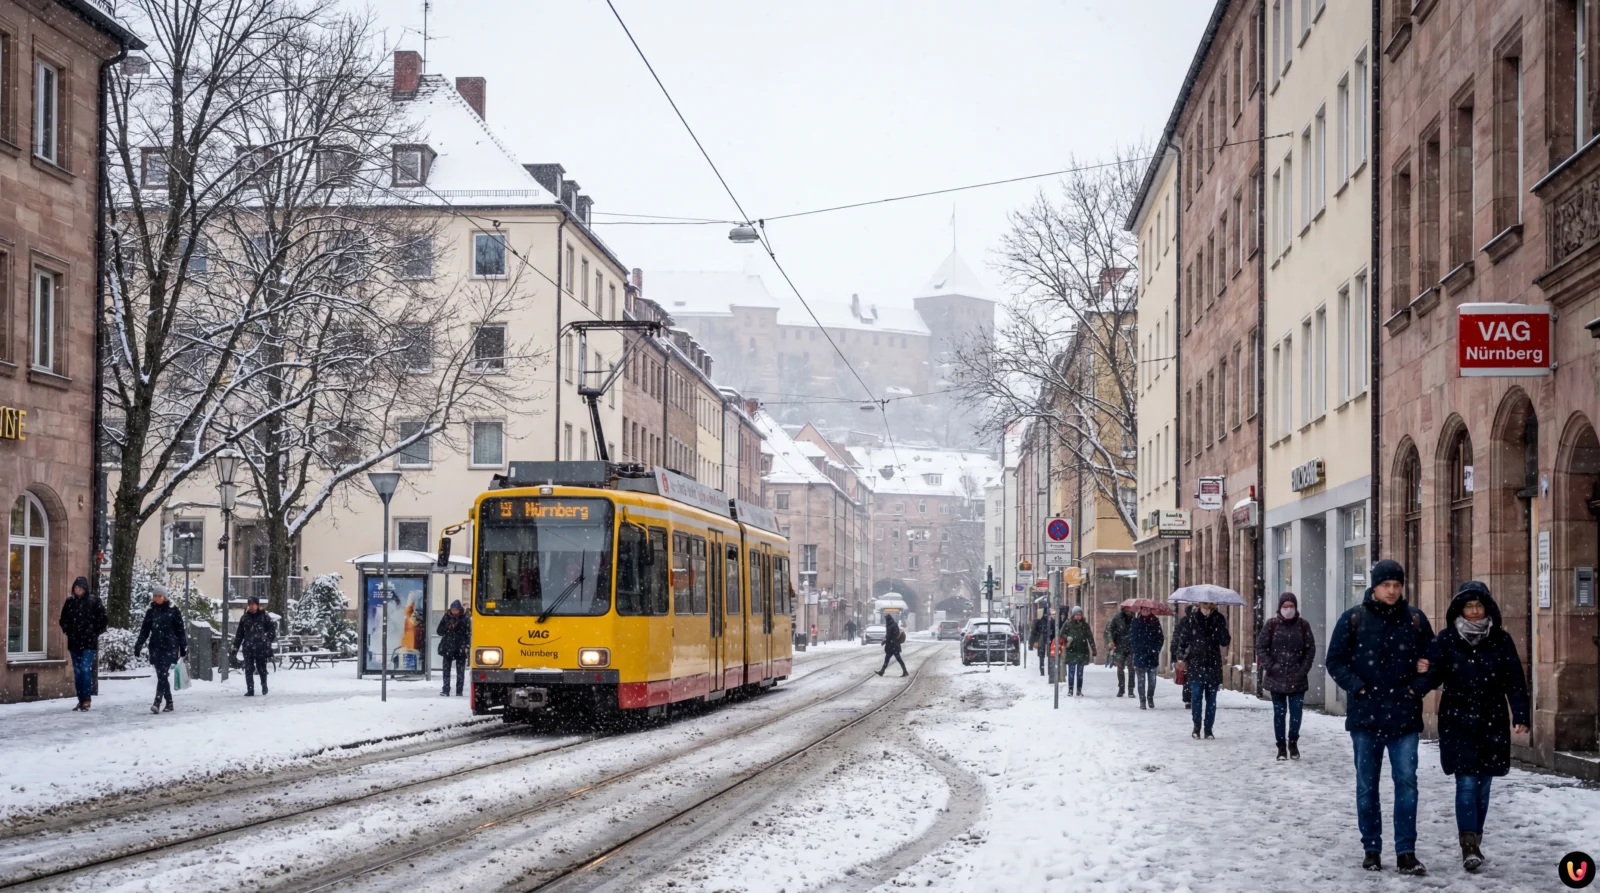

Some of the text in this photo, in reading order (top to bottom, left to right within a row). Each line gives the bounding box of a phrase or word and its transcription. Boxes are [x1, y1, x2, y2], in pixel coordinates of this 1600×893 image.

[1478, 321, 1531, 342] VAG
[1466, 346, 1543, 363] Nürnberg
[525, 502, 588, 520] Nürnberg
[528, 630, 550, 639] VAG
[520, 650, 559, 659] Nürnberg
